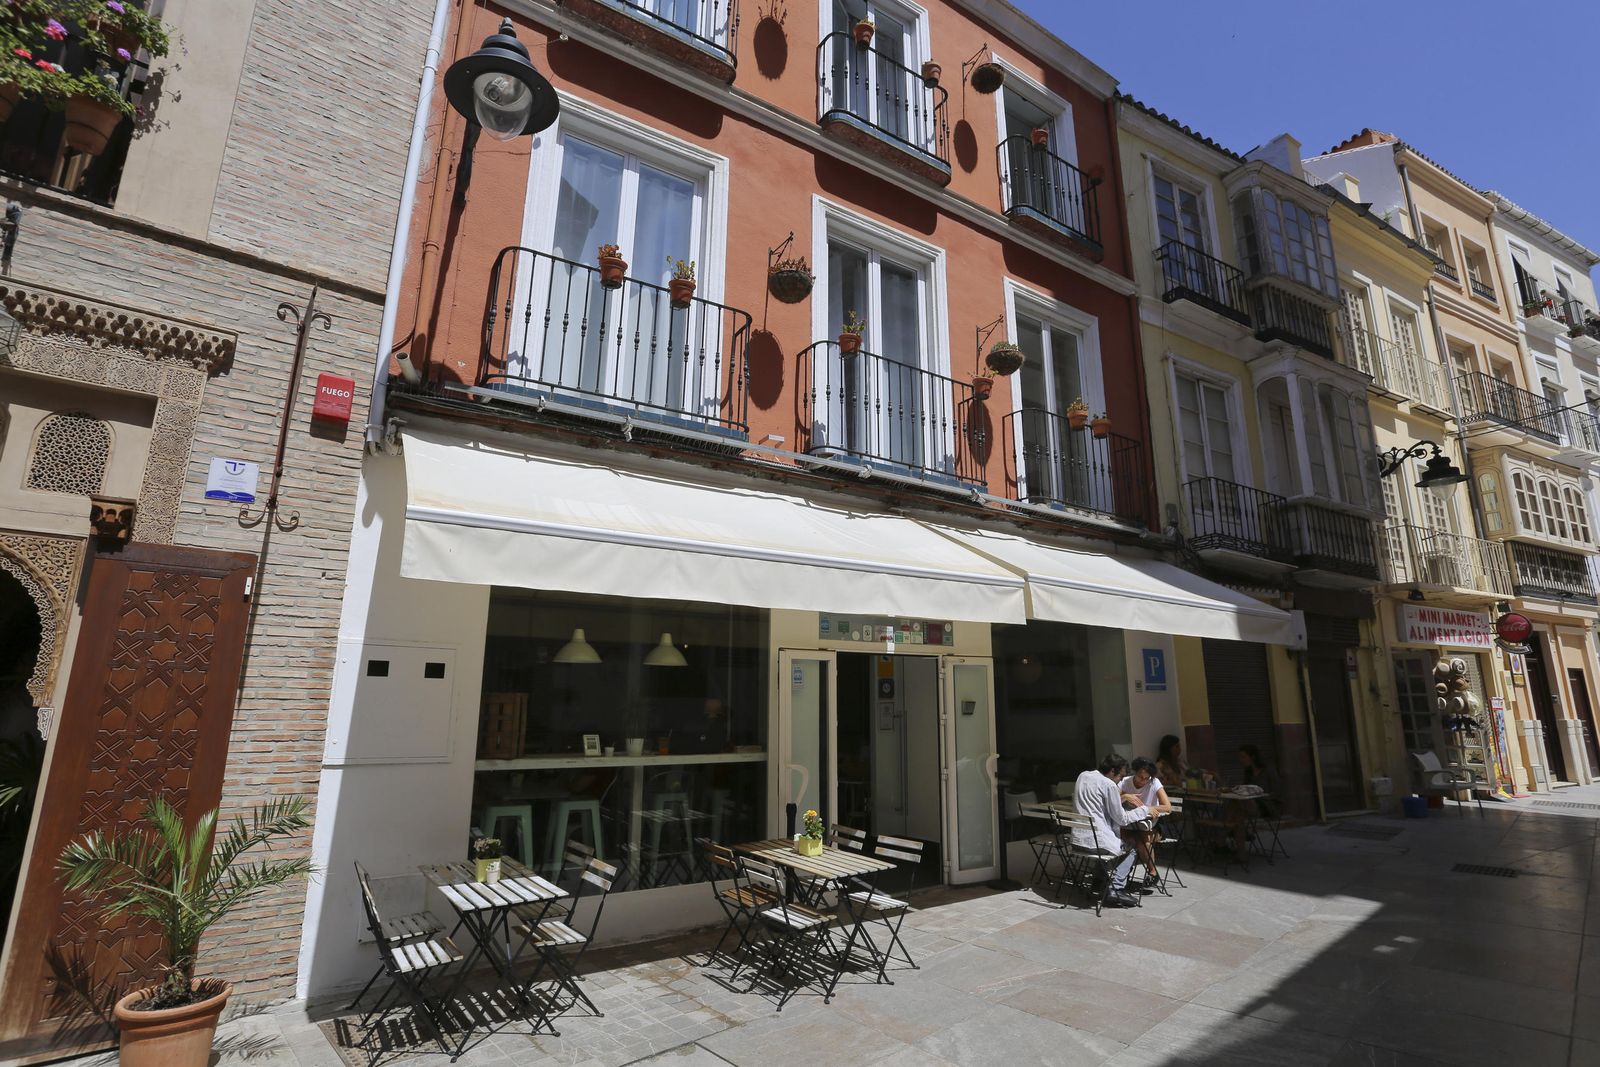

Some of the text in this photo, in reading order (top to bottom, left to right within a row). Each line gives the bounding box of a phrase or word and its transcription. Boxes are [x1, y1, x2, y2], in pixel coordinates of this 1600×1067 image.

[321, 386, 350, 398] FUEGO
[1418, 608, 1441, 624] MINI
[1443, 611, 1476, 629] MARKET
[1149, 656, 1160, 676] P
